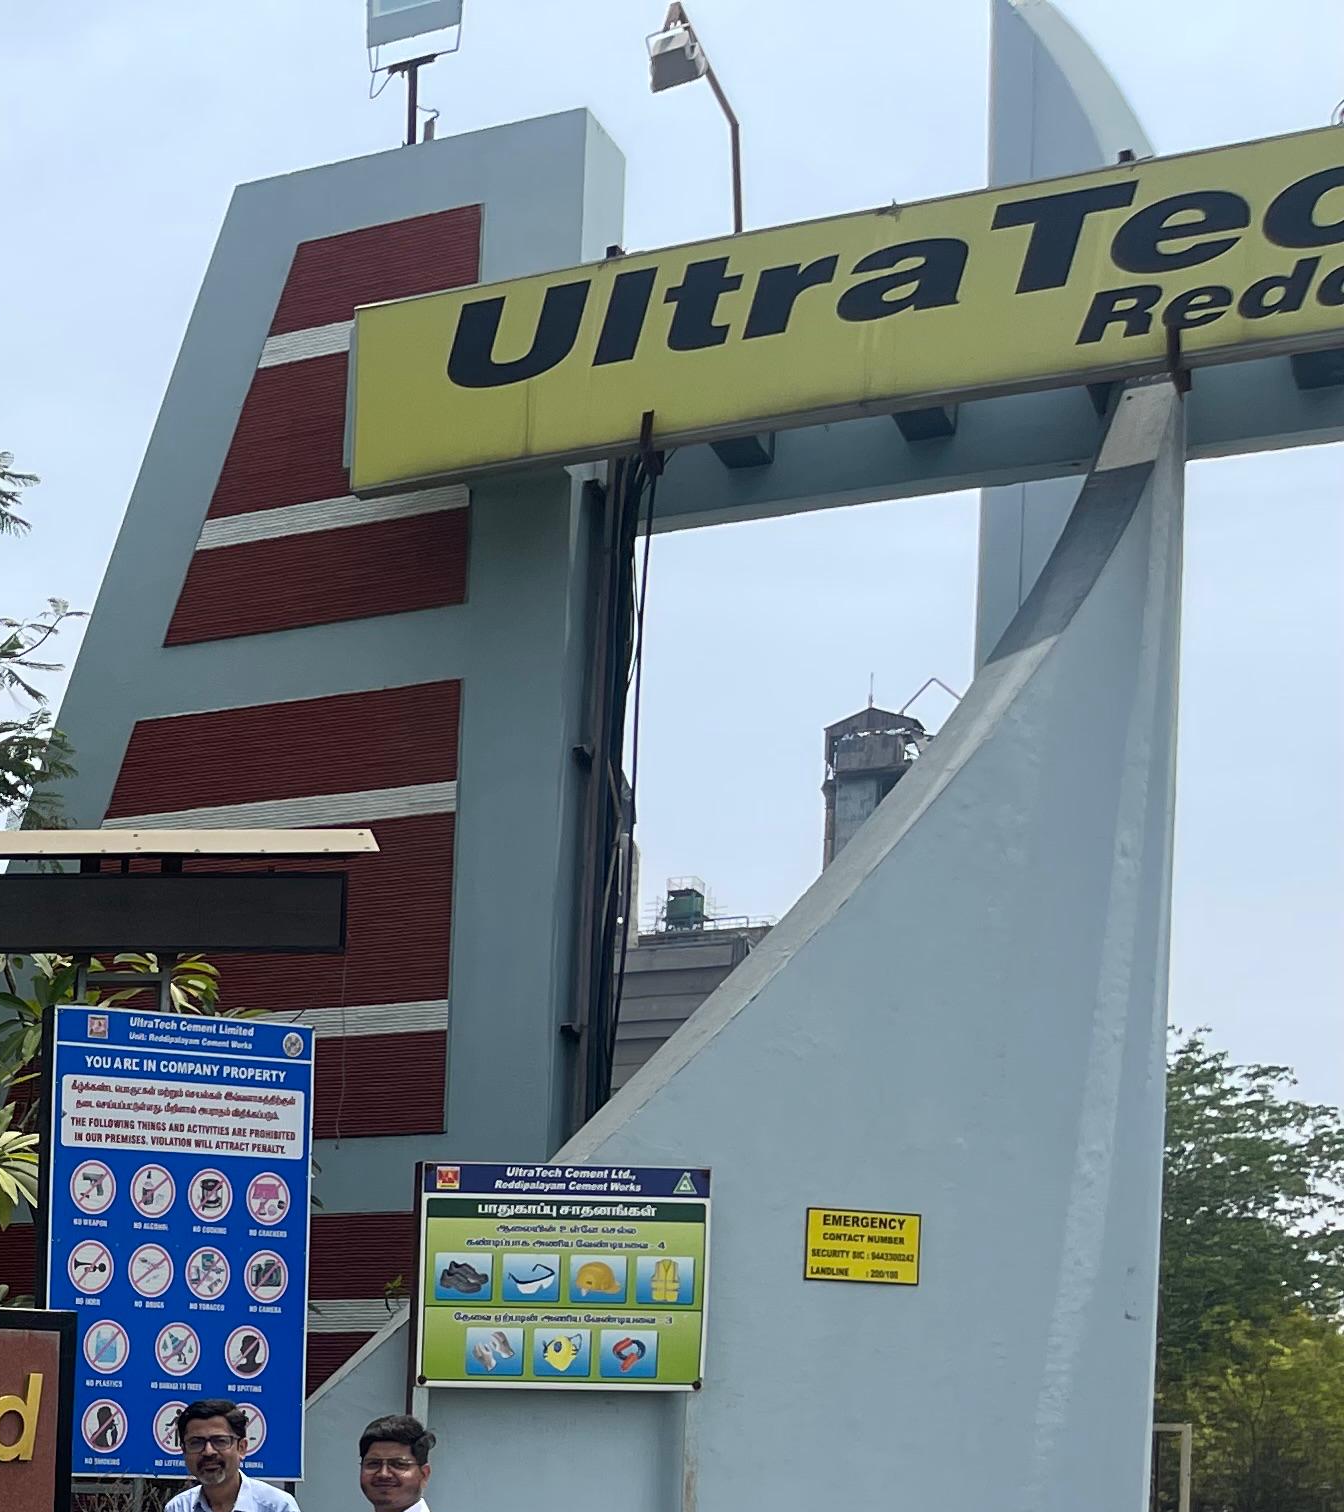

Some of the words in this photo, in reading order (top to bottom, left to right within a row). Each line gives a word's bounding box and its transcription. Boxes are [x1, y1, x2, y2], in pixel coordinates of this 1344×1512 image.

[129, 1016, 177, 1031] UltraTech
[179, 1020, 216, 1035] Cement
[218, 1024, 254, 1037] Limited
[128, 1031, 146, 1041] Unit:
[148, 1033, 200, 1046] Reddipalayam
[201, 1037, 230, 1049] Cement
[230, 1039, 253, 1050] Works
[85, 1055, 111, 1069] YOU
[113, 1057, 140, 1071] ARE
[143, 1059, 156, 1073] IN
[159, 1060, 220, 1077] COMPANY
[222, 1064, 287, 1083] PROPERTY
[70, 1116, 86, 1126] THE
[88, 1117, 135, 1130] FOLLOWING
[137, 1120, 166, 1132] THINGS
[168, 1121, 185, 1133] AND
[186, 1123, 229, 1136] ACTIVITIES
[231, 1125, 247, 1137] ARE
[249, 1127, 296, 1141] PROHIBITED
[73, 1131, 83, 1141] IN
[85, 1132, 103, 1142] OUR
[150, 1135, 192, 1148] VIOLATION
[194, 1138, 213, 1149] WILL
[215, 1139, 250, 1152] ATTRACT
[506, 1166, 562, 1178] UltraTech
[565, 1168, 609, 1179] Cement
[494, 1179, 566, 1192] Reddipalayam
[569, 1180, 609, 1191] Cement
[611, 1182, 642, 1193] Works
[477, 1203, 557, 1217] பாதுகாப்பு
[559, 1203, 658, 1218] சாதனங்கள்
[823, 1213, 906, 1231] EMERGENCY
[822, 1232, 865, 1243] CONTACT
[867, 1235, 905, 1245] NUMBER
[811, 1248, 850, 1259] SECURITY
[810, 1265, 850, 1277] LANDLINE
[95, 1379, 123, 1388] PLASTICS
